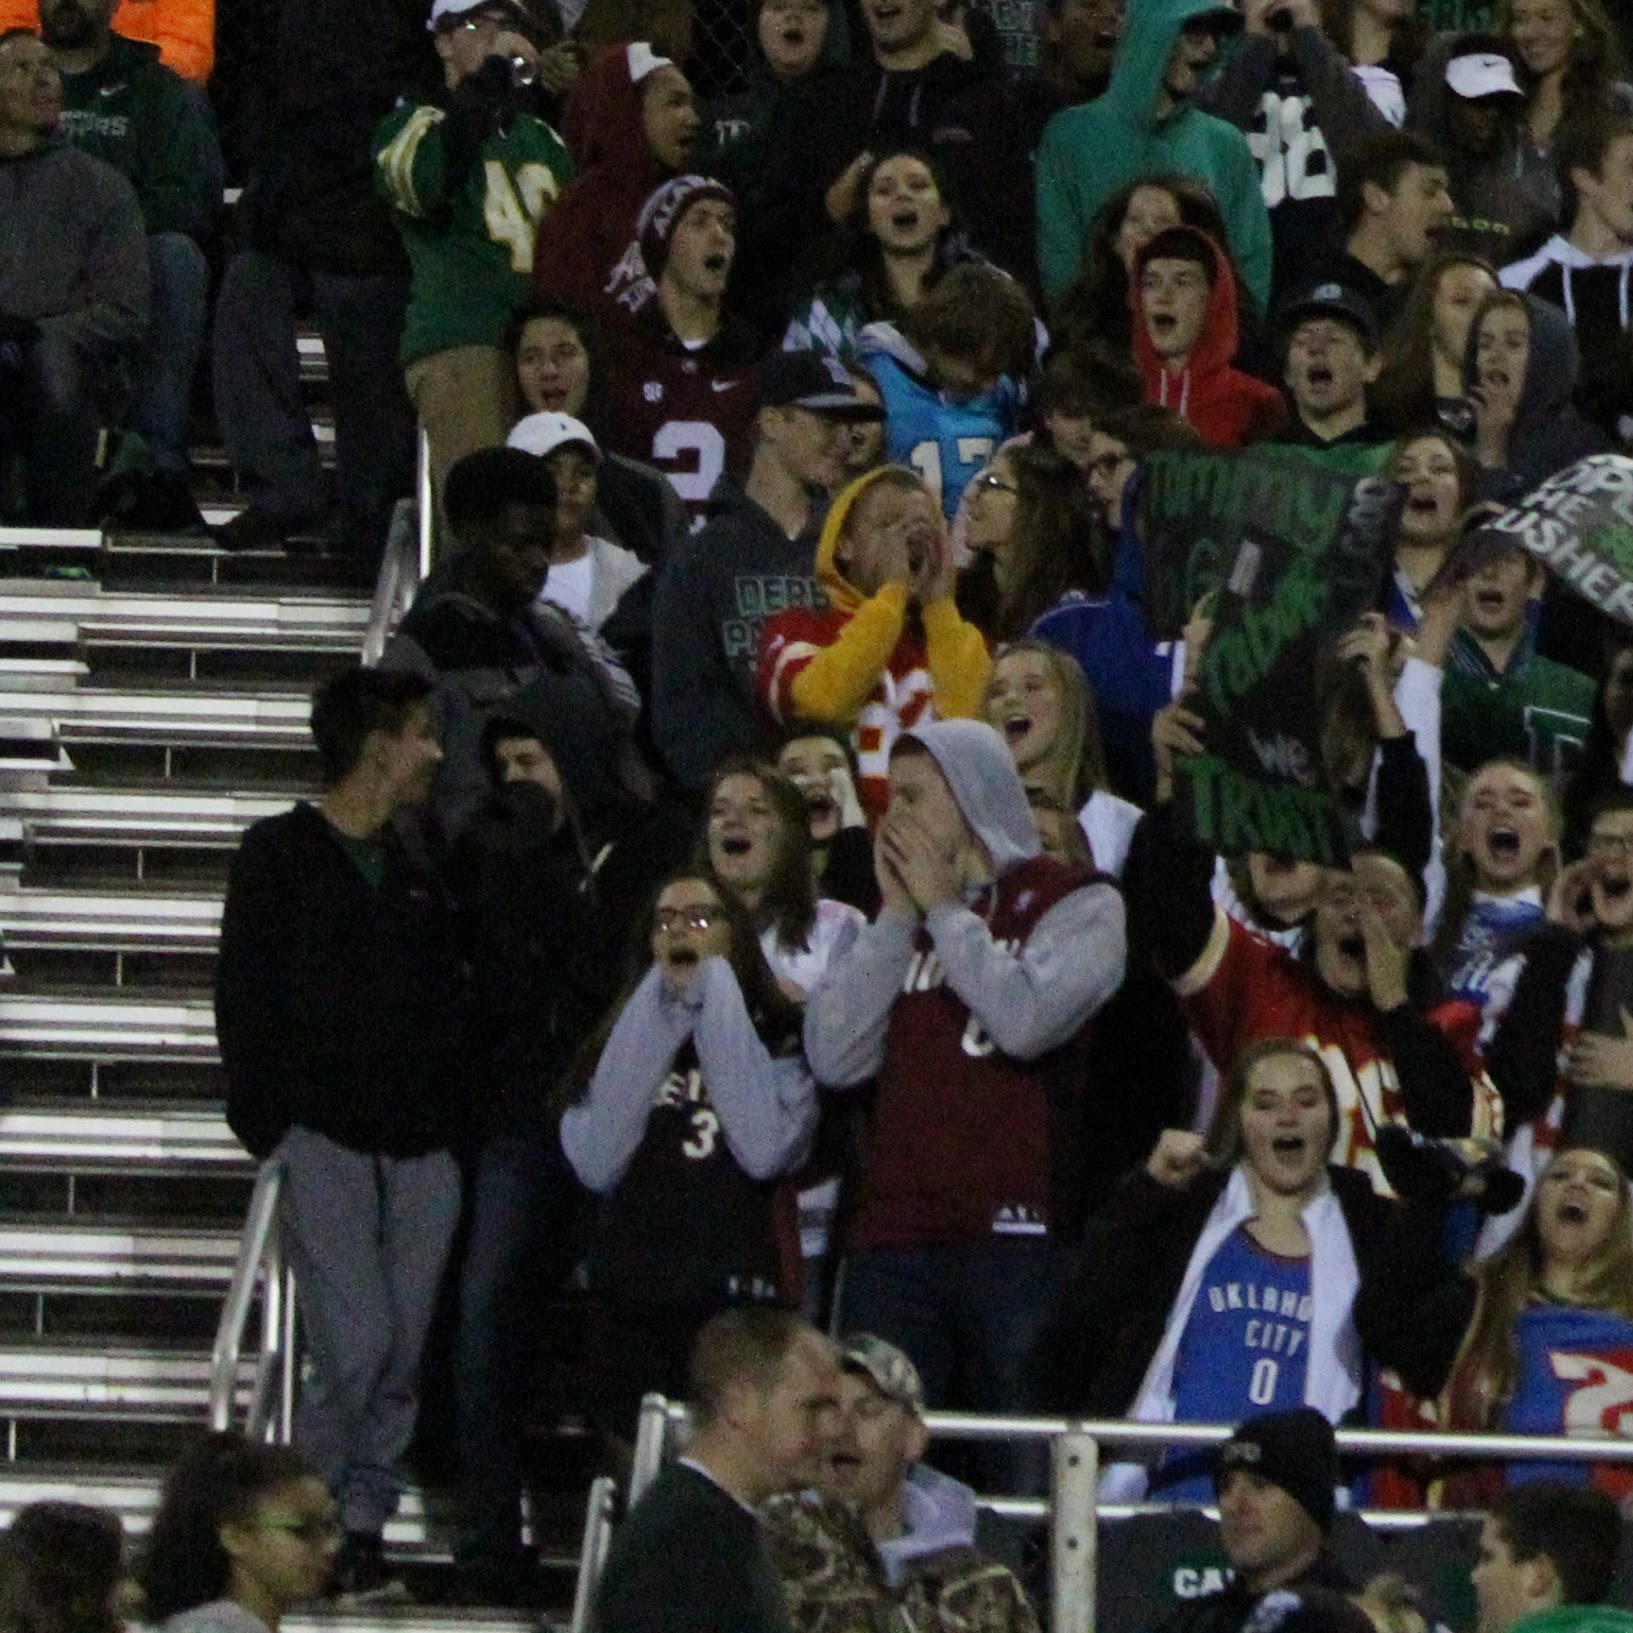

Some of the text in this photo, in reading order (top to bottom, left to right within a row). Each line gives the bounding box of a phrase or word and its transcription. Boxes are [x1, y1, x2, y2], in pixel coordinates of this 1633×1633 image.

[682, 1108, 721, 1160] 3
[1244, 1319, 1305, 1357] CITY
[1250, 1357, 1279, 1405] 0
